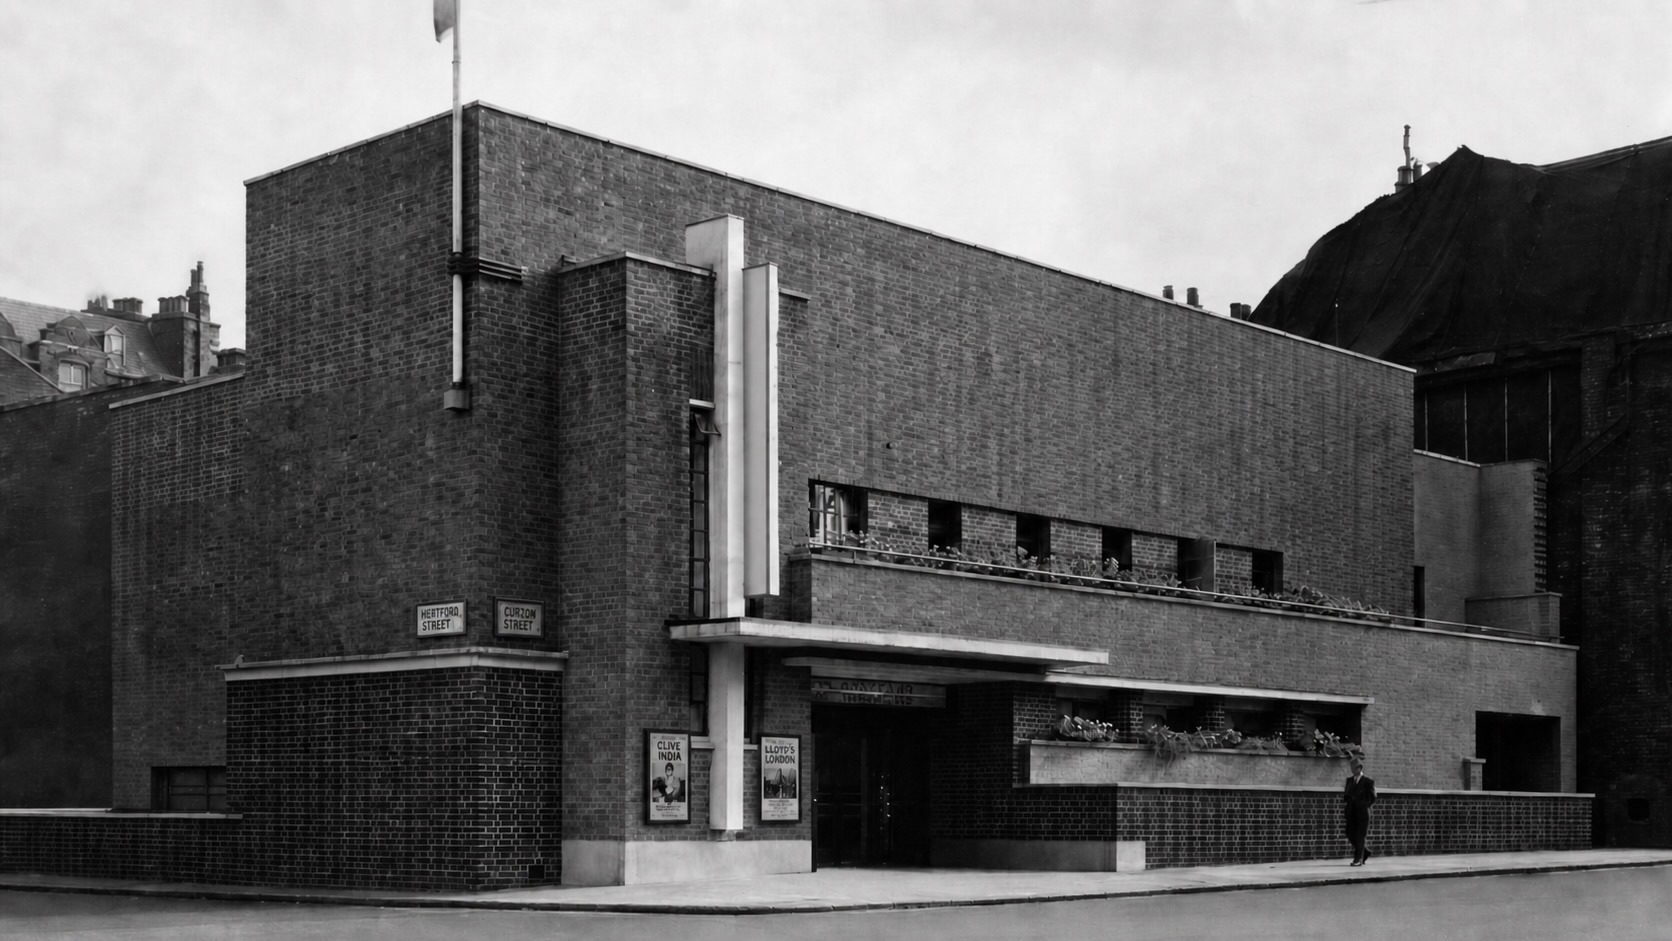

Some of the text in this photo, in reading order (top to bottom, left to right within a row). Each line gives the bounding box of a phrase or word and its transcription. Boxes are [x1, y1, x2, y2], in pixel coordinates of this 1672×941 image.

[504, 606, 536, 619] CURZON
[422, 618, 451, 631] STREET
[504, 619, 533, 631] STREET
[657, 740, 681, 751] CLIVE
[658, 751, 682, 761] INDIA
